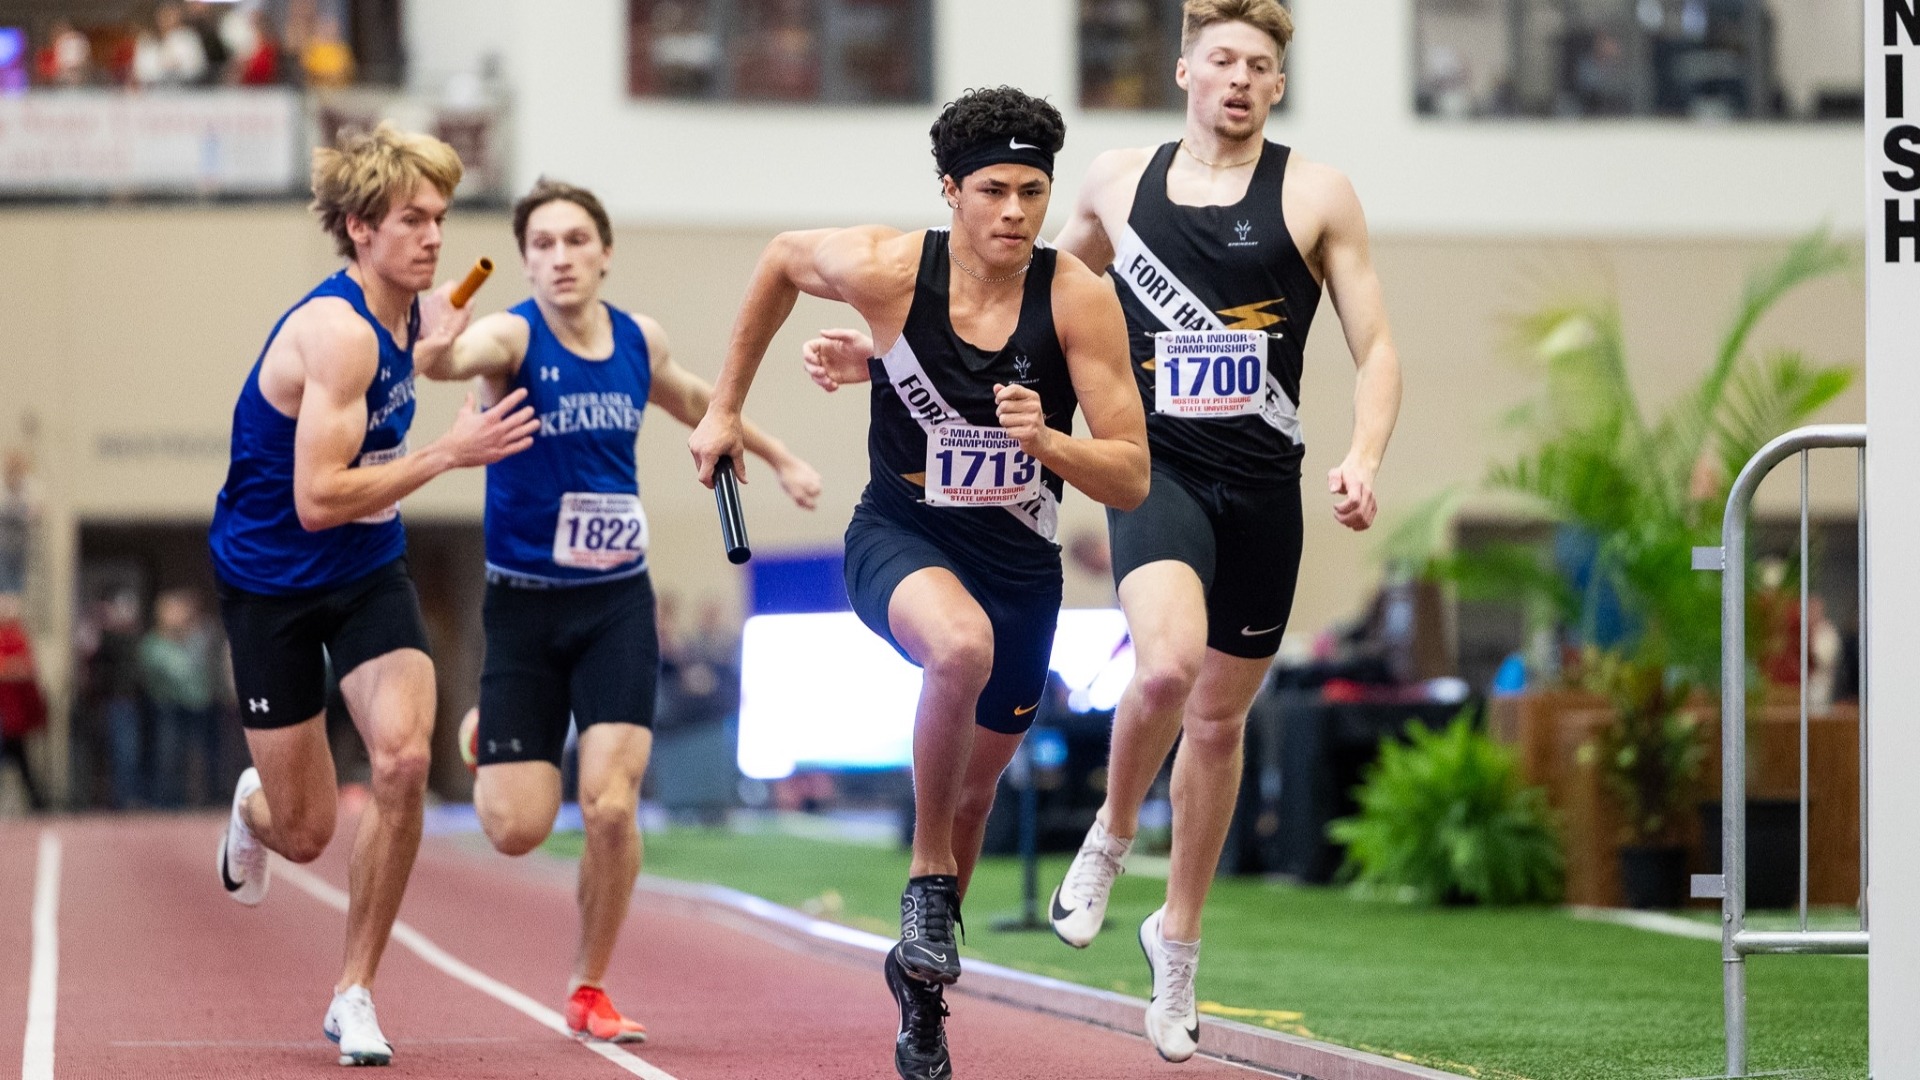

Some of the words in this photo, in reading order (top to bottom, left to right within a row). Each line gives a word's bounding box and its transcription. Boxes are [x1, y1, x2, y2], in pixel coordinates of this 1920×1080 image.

[1129, 254, 1181, 308] FORT
[1175, 334, 1204, 344] MIAA
[1207, 334, 1248, 343] INDOOR
[1167, 343, 1257, 354] CHAMPIONSHIPS
[1164, 355, 1261, 397] 1700
[1172, 397, 1200, 405] HOSTED
[1213, 396, 1251, 404] PITTSBURG
[1204, 404, 1244, 412] UNIVERSITY
[950, 428, 980, 439] MIAA
[936, 450, 1037, 487] 1713
[985, 486, 1025, 495] PITTSBURG
[976, 493, 1018, 502] UNIVERSITY
[568, 517, 641, 550] 1822
